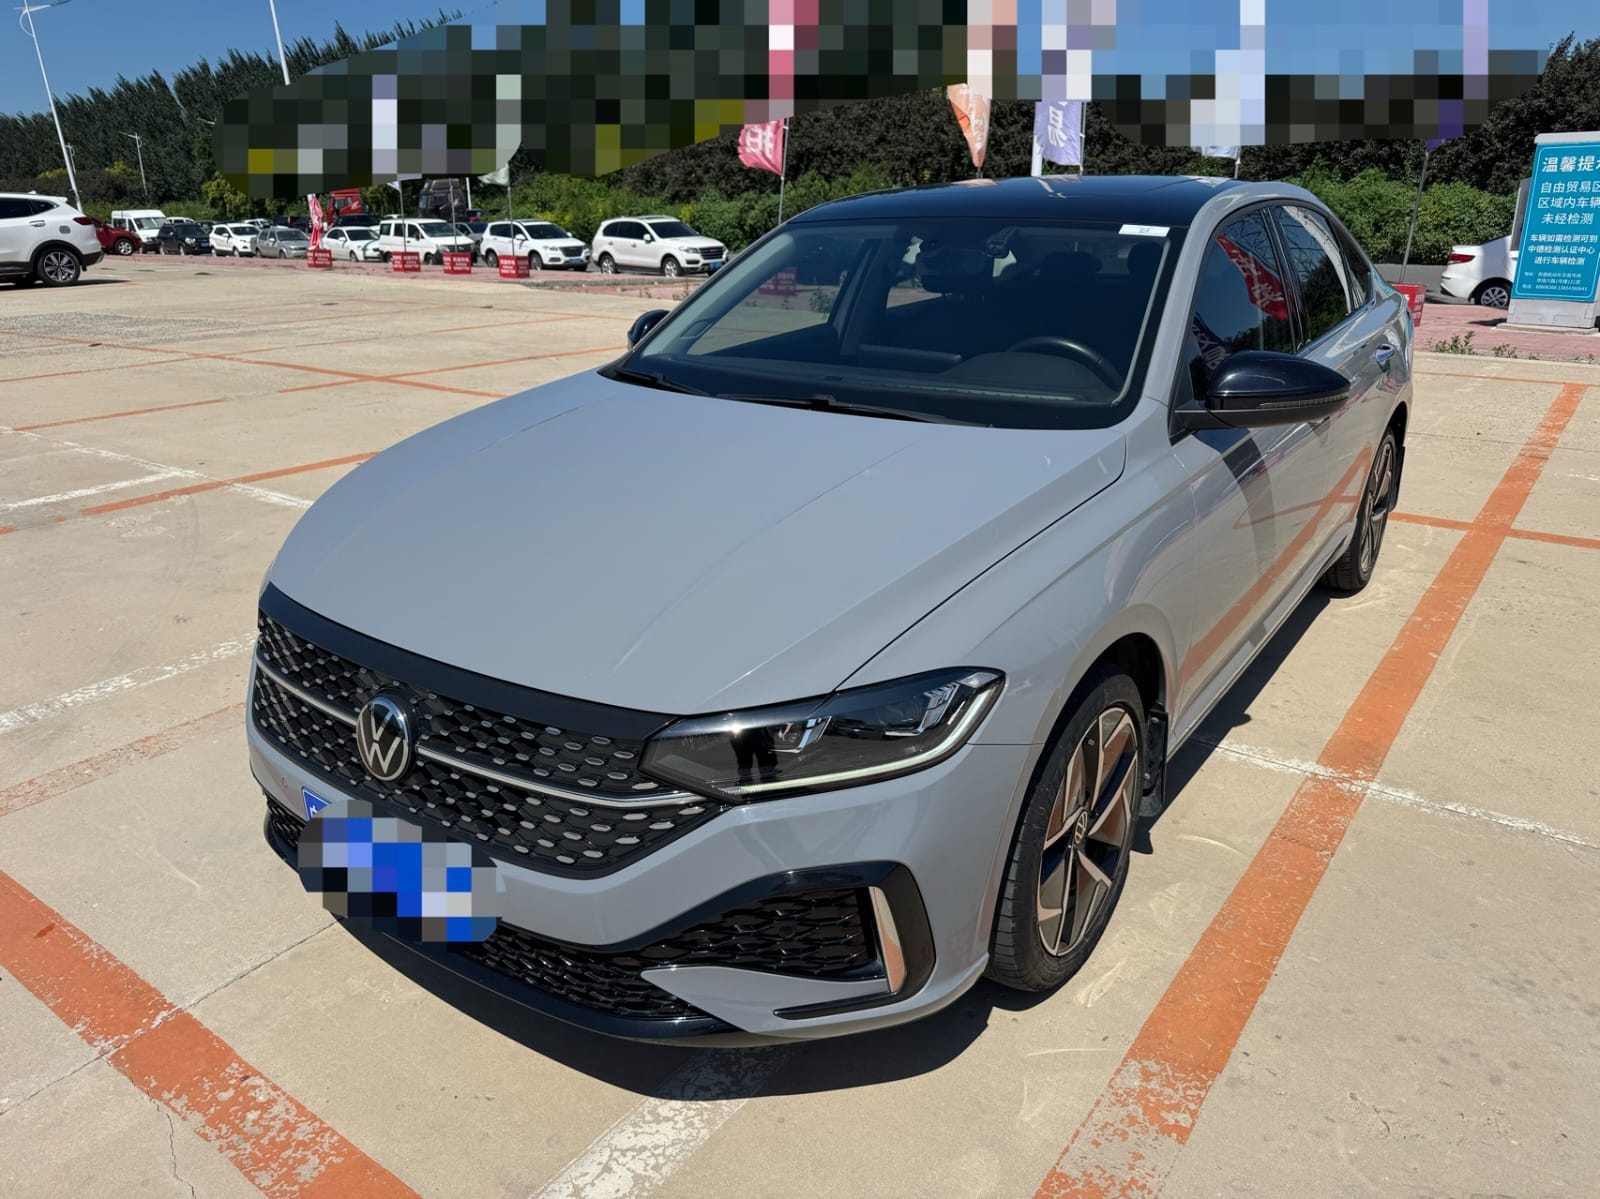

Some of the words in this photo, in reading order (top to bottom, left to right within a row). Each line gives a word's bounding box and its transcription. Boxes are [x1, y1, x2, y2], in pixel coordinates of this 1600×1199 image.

[1541, 180, 1600, 193] 自由贸易区
[1537, 196, 1600, 209] 区域内车辆
[1541, 212, 1594, 225] 未经检测
[1530, 234, 1598, 243] 车辆如需检测可到
[1534, 256, 1585, 265] 进行车辆检测
